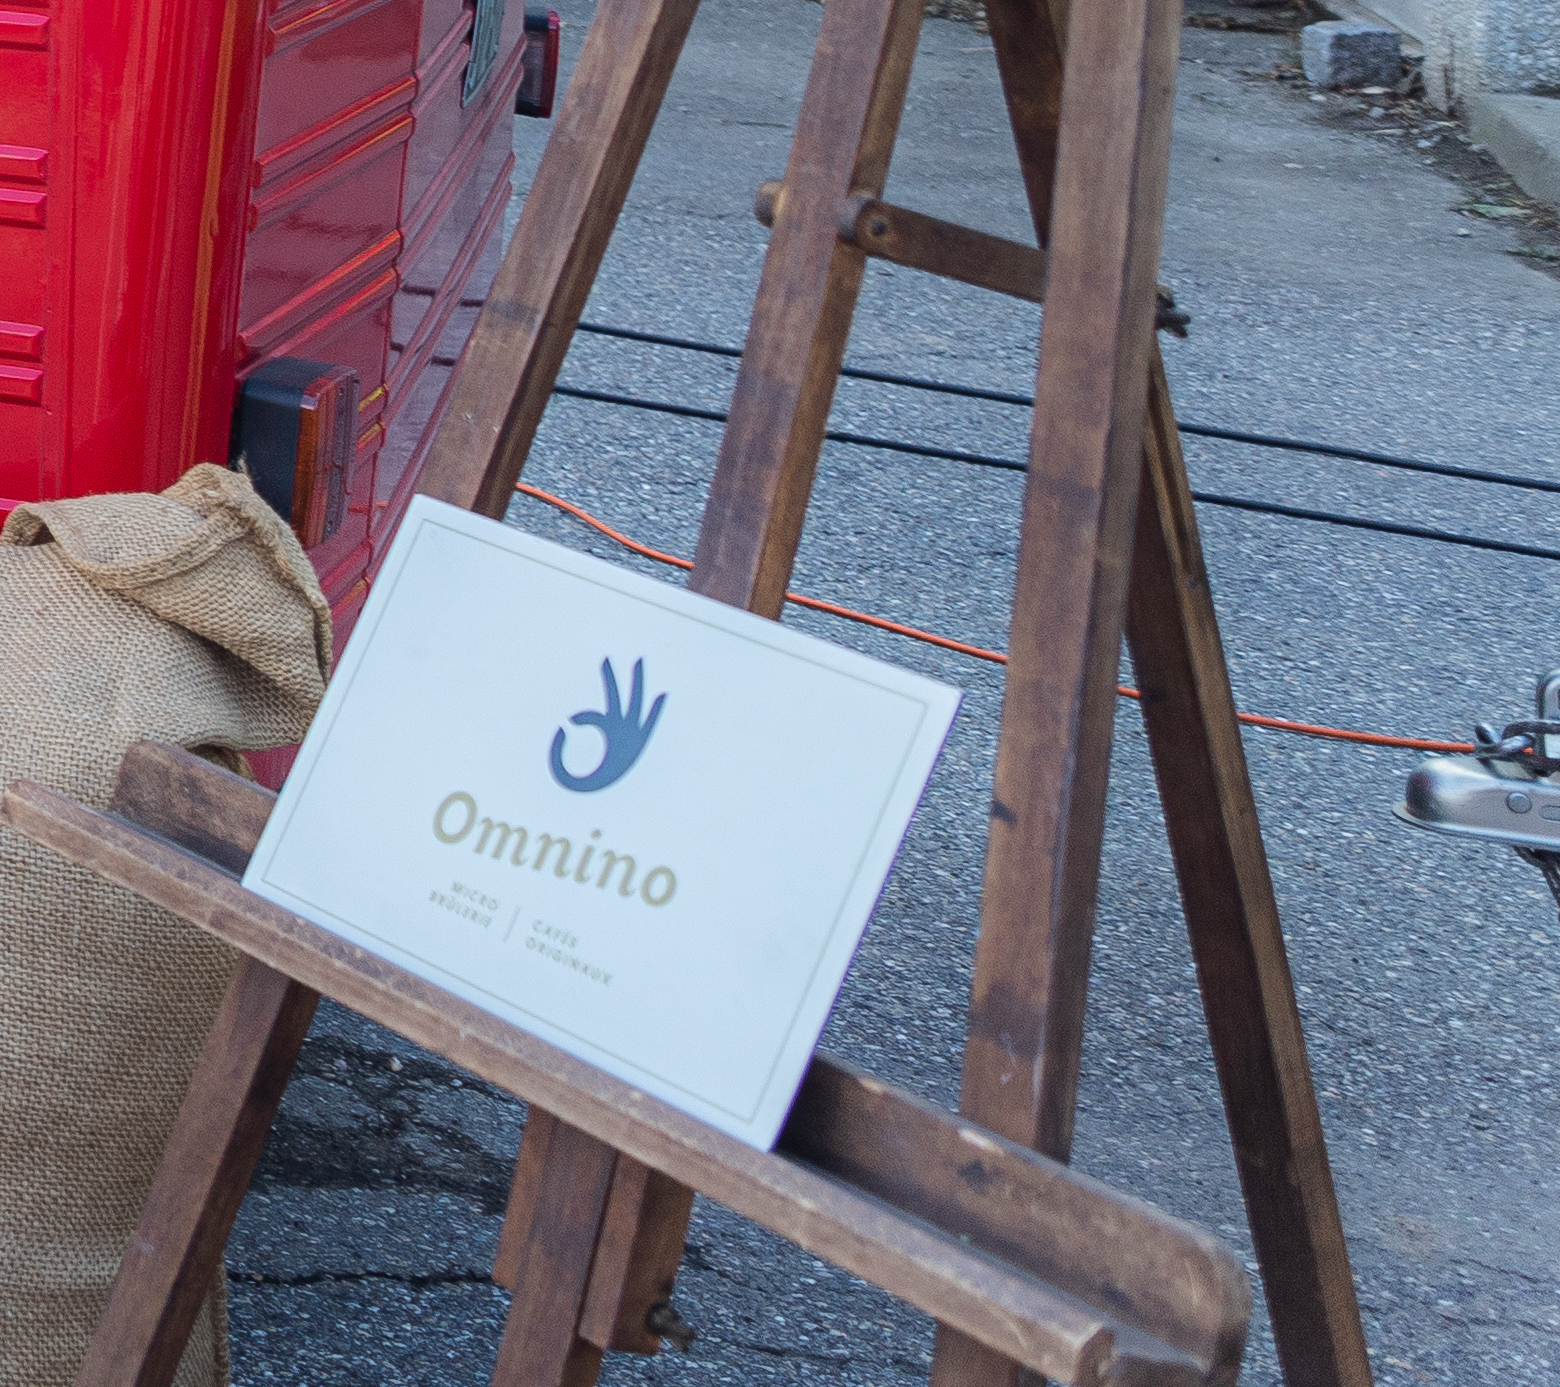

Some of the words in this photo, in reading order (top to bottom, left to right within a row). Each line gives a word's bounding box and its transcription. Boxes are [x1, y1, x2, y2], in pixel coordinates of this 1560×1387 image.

[432, 791, 677, 907] Omnino
[428, 890, 492, 929] BRÛLERIE
[451, 881, 500, 911] MICRO
[532, 919, 578, 949] CAFÉS
[525, 936, 613, 985] ORIGINAUX
